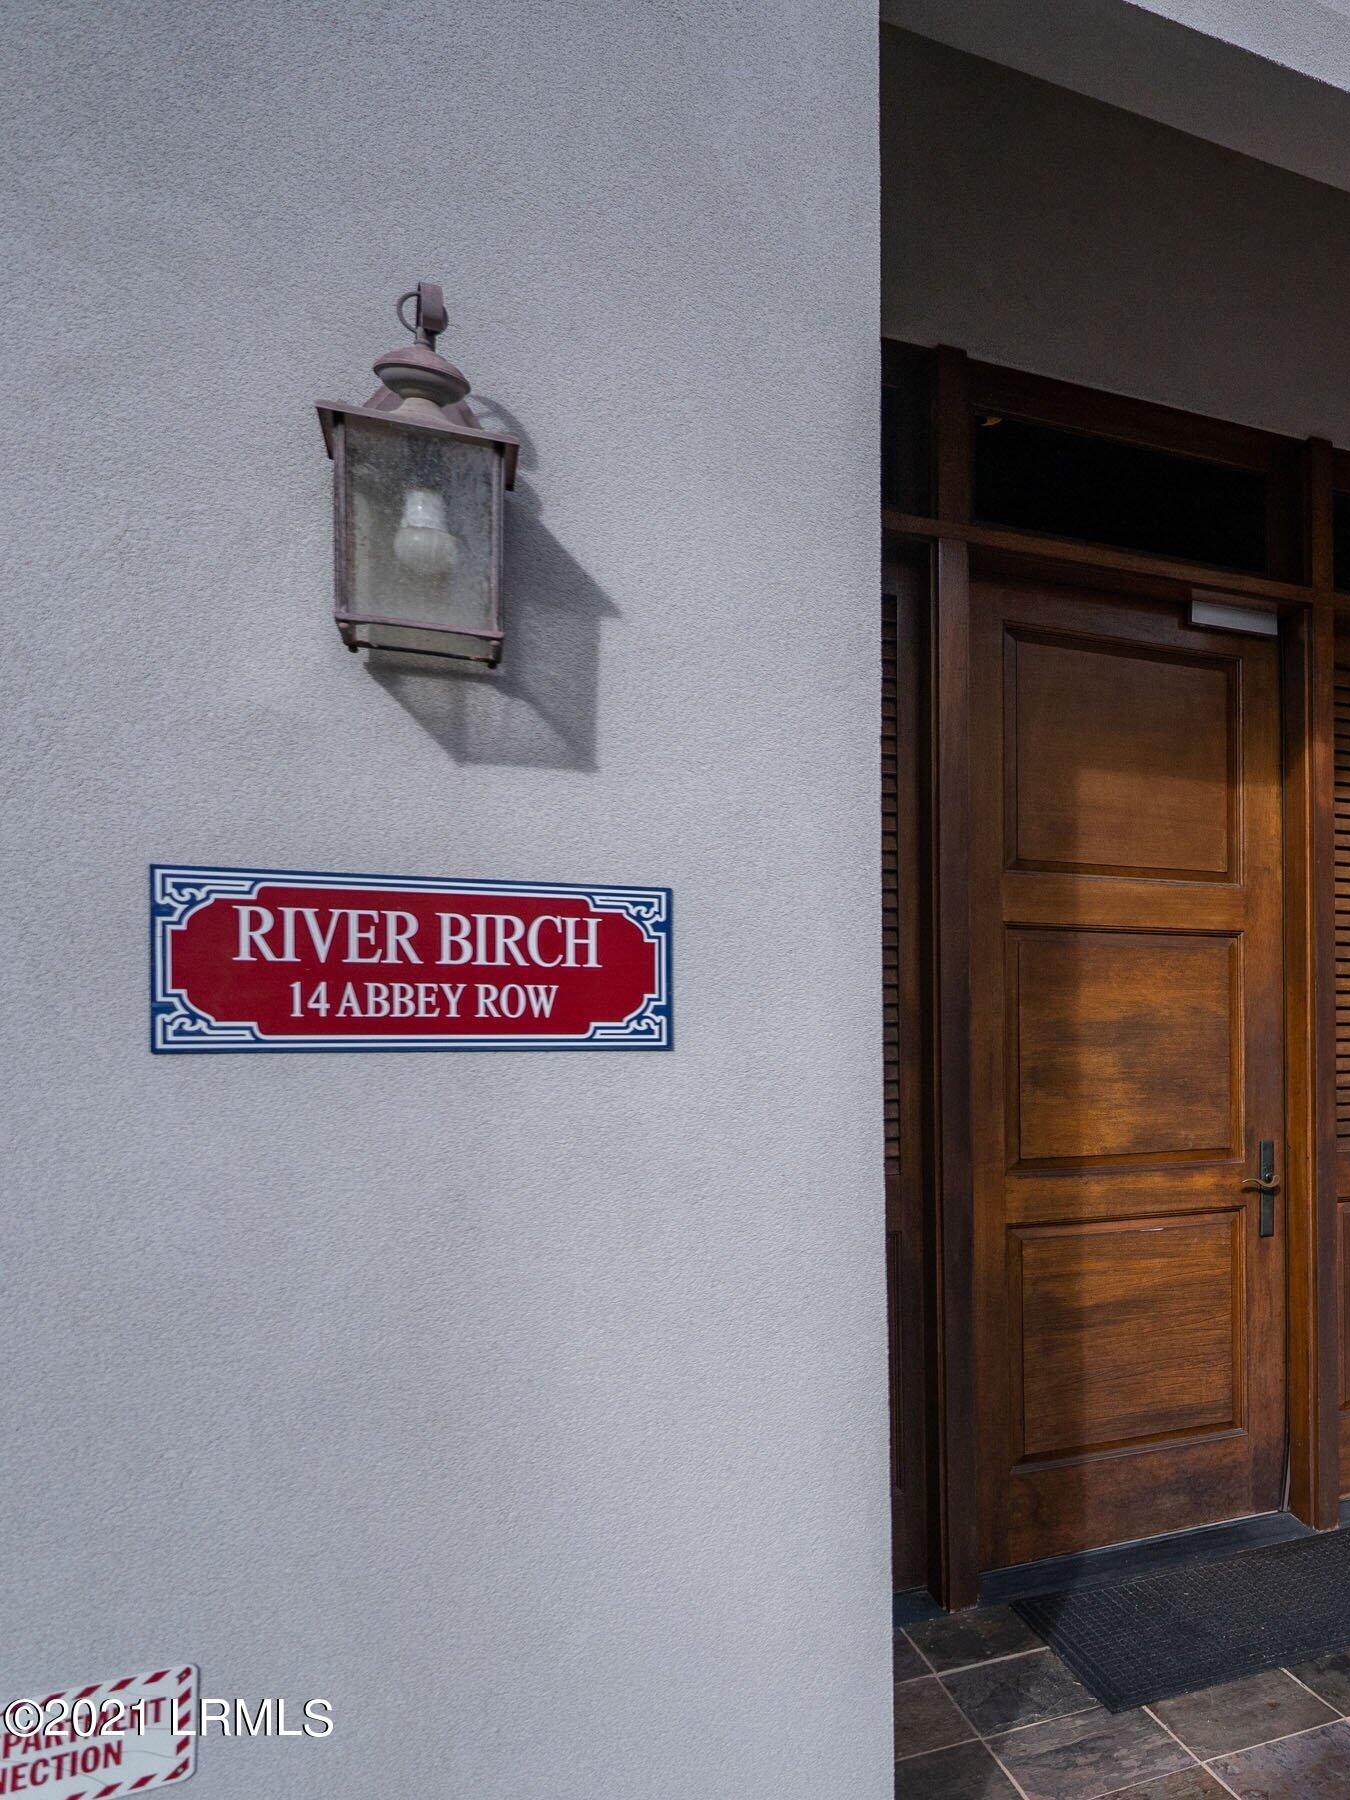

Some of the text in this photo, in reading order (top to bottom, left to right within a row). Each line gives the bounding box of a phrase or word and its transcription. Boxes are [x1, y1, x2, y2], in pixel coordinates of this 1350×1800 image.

[231, 904, 603, 969] RIVER BIRCH
[289, 981, 560, 1019] 14 ABBEY ROW
